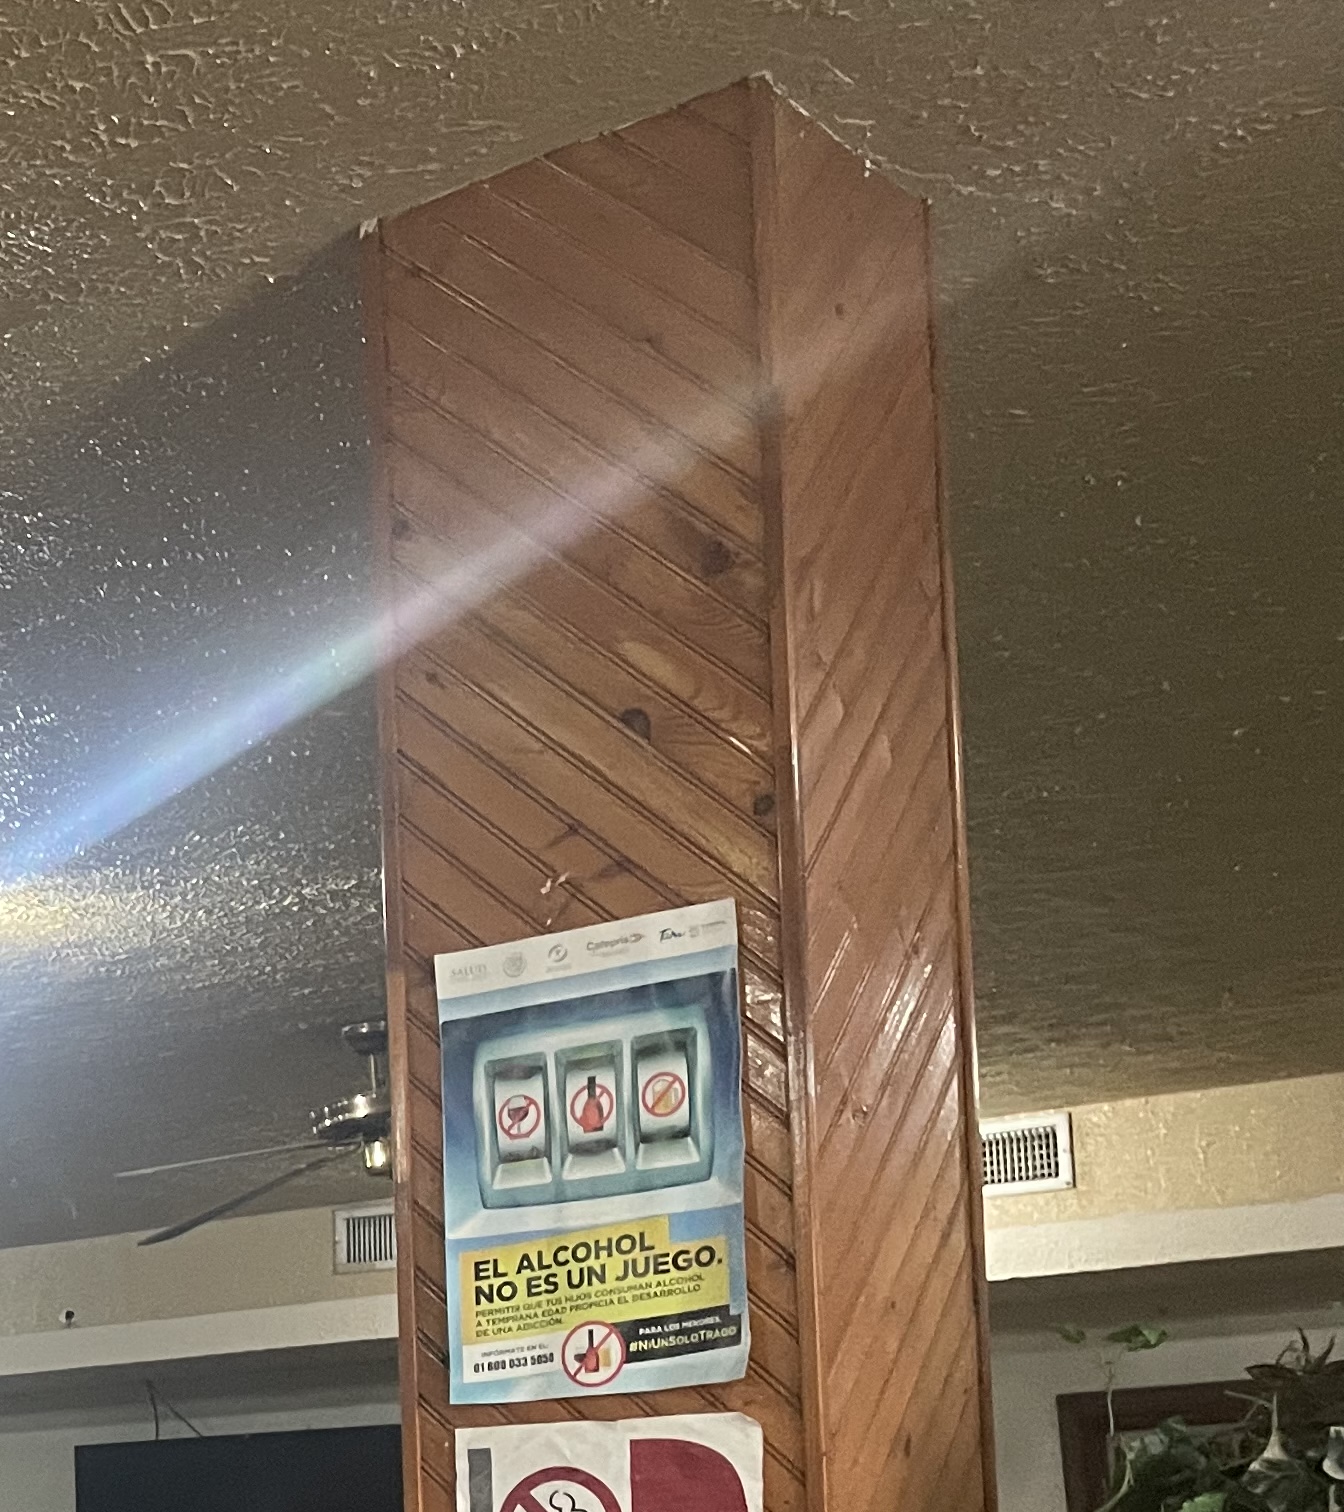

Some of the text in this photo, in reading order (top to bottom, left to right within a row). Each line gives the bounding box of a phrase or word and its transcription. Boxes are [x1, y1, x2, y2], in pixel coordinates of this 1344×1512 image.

[474, 1231, 655, 1281] EL ALCOHOL
[475, 1245, 723, 1306] NO ES UN JUEGO.
[475, 1272, 705, 1318] PERMITIR QUE TUS HIJOS CONSUMAN ALCOHOL
[475, 1284, 701, 1328] A TEMPRANA EDAD PROPICIA EL DESARROLLO
[475, 1328, 490, 1338] DE
[492, 1326, 514, 1336] UNA
[639, 1324, 662, 1335] PARA
[664, 1321, 680, 1332] LOS
[473, 1362, 485, 1374] 01
[487, 1359, 507, 1371] 800
[509, 1356, 528, 1369] 033
[481, 1346, 525, 1358] INFÓRMATE
